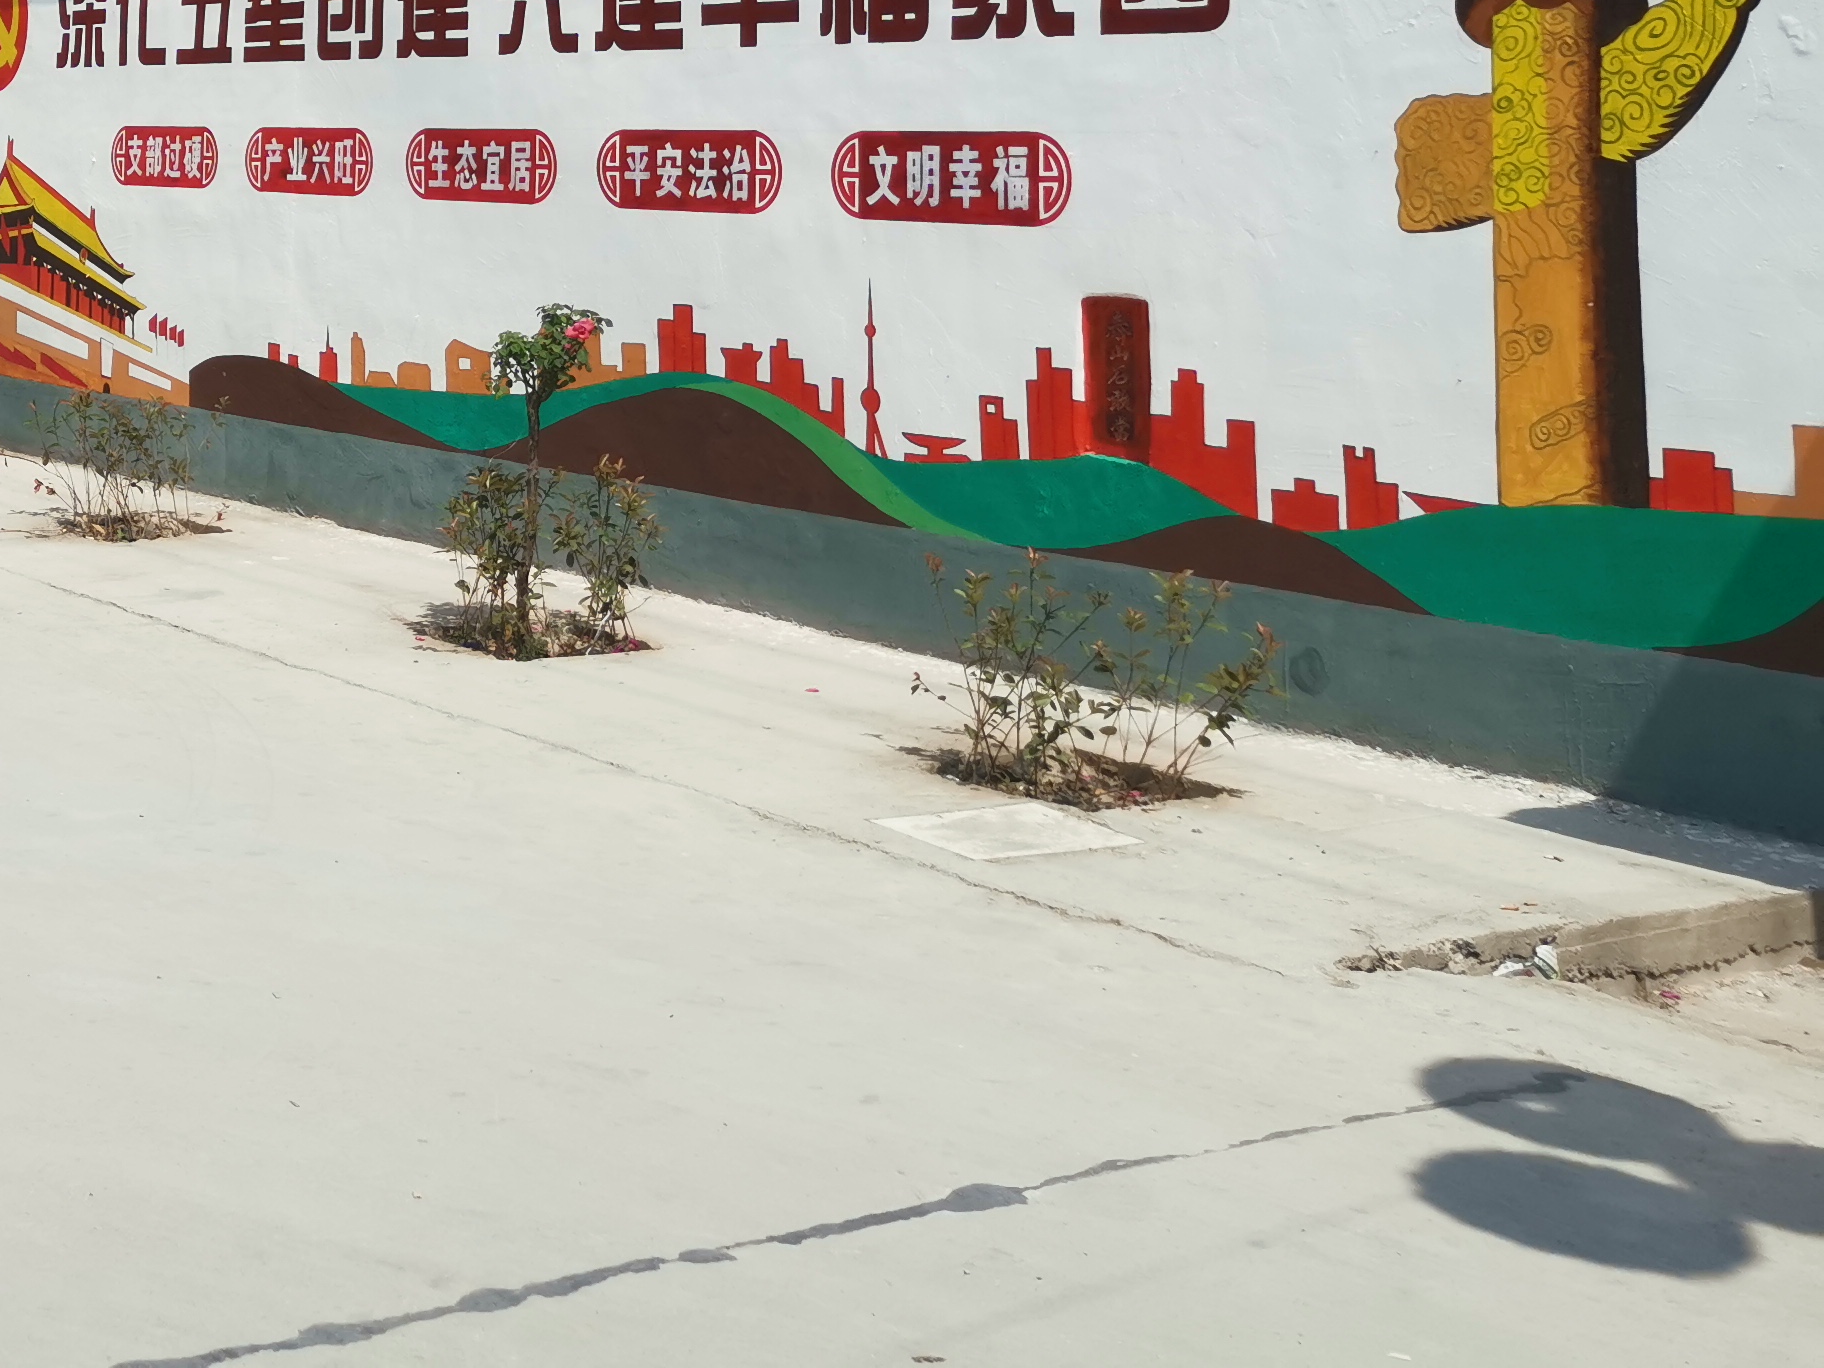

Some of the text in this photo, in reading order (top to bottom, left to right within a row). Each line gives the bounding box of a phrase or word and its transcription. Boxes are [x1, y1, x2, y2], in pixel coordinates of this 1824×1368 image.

[126, 134, 202, 180] 支部过硬
[263, 136, 354, 185] 产业兴旺
[427, 139, 533, 192] 生态宜居
[623, 142, 752, 201] 平安法治
[865, 144, 1030, 211] 文明幸福
